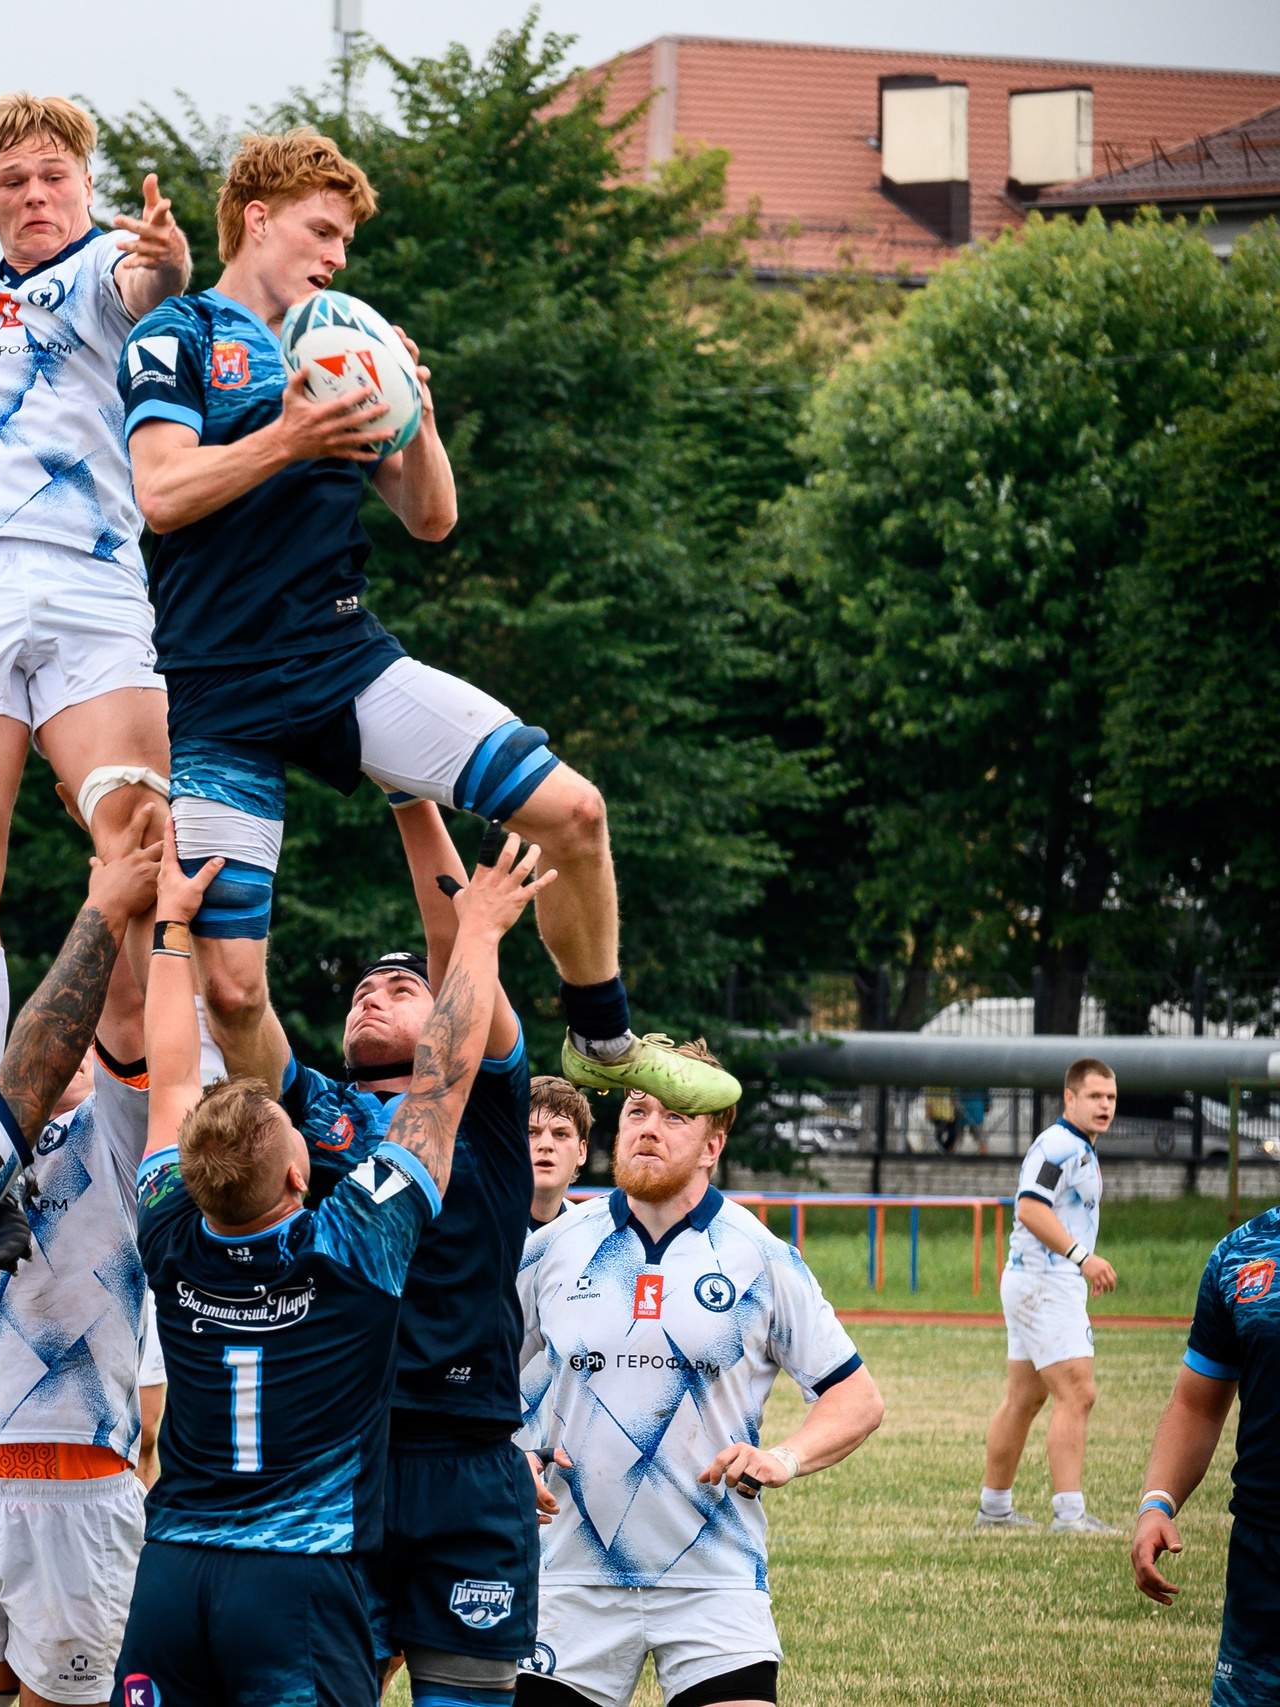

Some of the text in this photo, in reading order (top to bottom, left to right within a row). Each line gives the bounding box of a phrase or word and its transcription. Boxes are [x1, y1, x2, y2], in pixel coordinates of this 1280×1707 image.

[177, 1282, 317, 1322] Балтийский Парус
[566, 1291, 601, 1302] centurion
[616, 1354, 721, 1378] ГЕРОФАРМ
[222, 1345, 263, 1473] 1
[454, 1587, 511, 1609] ШТОРМ
[58, 1673, 97, 1682] ceturion
[130, 1688, 145, 1706] K
